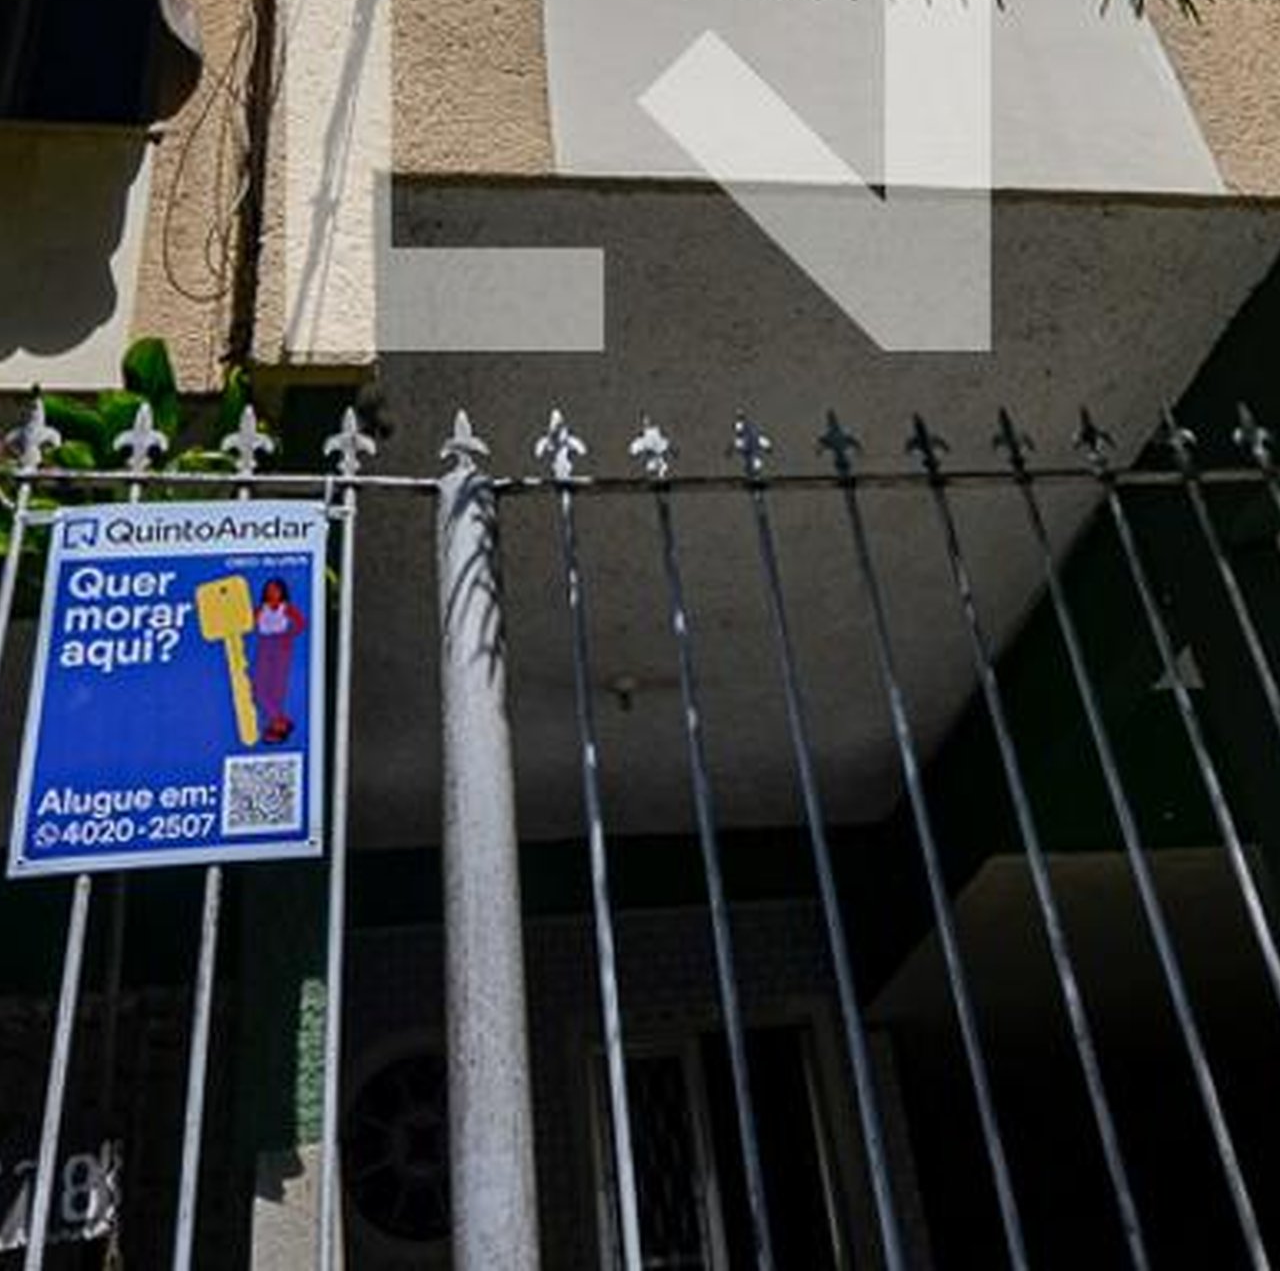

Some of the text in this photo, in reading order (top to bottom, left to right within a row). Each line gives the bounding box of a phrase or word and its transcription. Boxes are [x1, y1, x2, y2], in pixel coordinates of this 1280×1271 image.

[106, 515, 315, 546] QuintoAndar
[68, 566, 176, 600] Quer
[64, 602, 192, 633] morar
[59, 628, 180, 673] aqui?
[37, 784, 217, 819] Alugue em:
